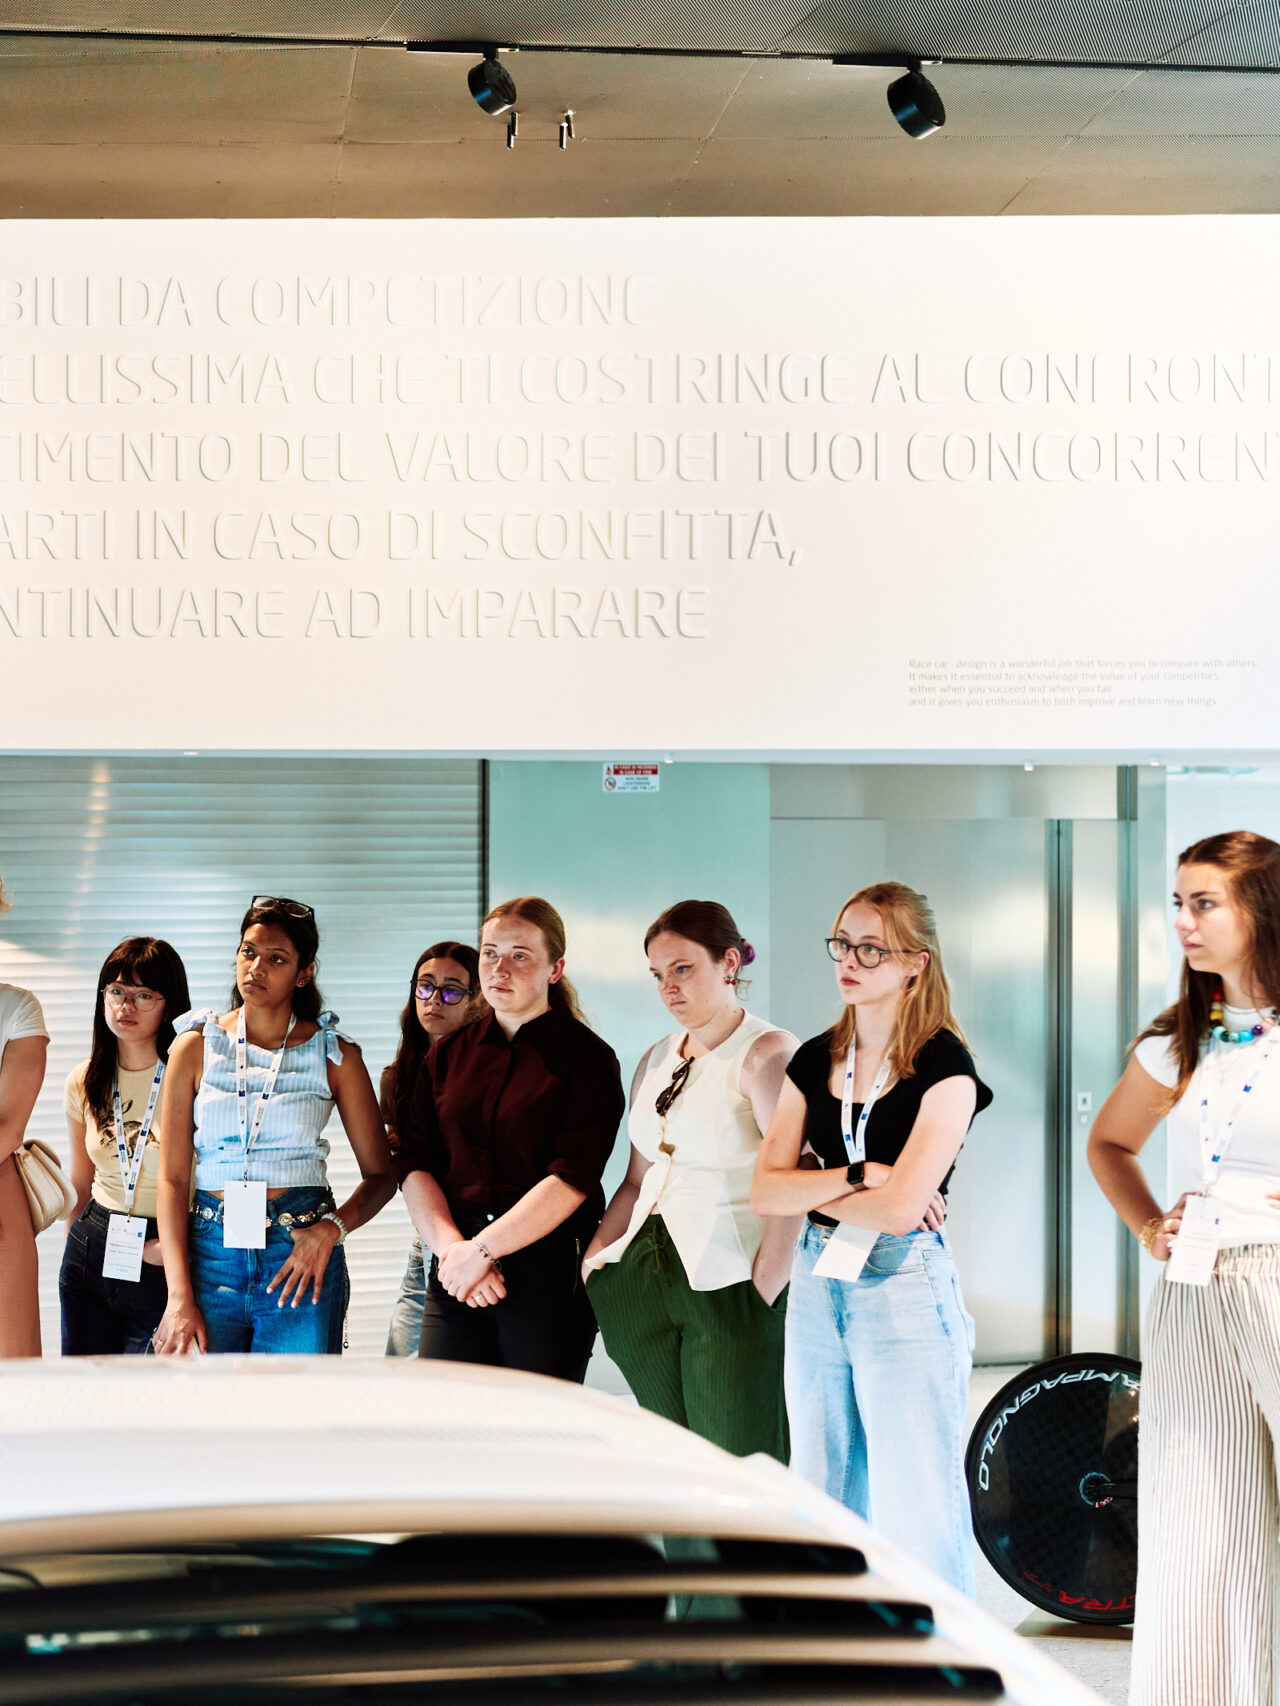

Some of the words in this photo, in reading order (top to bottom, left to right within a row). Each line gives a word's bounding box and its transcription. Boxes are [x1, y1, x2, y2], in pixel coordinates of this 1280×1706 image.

[118, 275, 197, 328] DA
[215, 275, 659, 328] COMPETIZIONE
[312, 353, 426, 405] CHE
[444, 353, 498, 405] TI
[519, 353, 854, 405] COSTRINGE
[870, 353, 944, 405] AL
[258, 431, 368, 483] DEL
[384, 431, 616, 483] VALORE
[632, 431, 727, 483] DEI
[743, 431, 887, 483] TUOI
[905, 431, 1280, 483] CONCORREN
[135, 509, 194, 561] IN
[211, 509, 368, 561] CASO
[387, 509, 442, 561] DI
[463, 509, 803, 567] SCONFITTA,
[304, 587, 389, 640] AD
[409, 587, 711, 640] IMPARARE
[909, 658, 932, 669] Race
[955, 658, 987, 670] design
[989, 658, 997, 669] is
[1007, 658, 1056, 669] wonderful
[1057, 658, 1072, 670] job
[1075, 658, 1094, 669] that
[1097, 658, 1126, 669] forces
[1128, 661, 1145, 670] you
[1148, 658, 1159, 669] to
[1160, 661, 1200, 670] compare
[1202, 658, 1224, 669] with
[918, 672, 948, 681] makes
[950, 672, 957, 681] it
[960, 672, 1002, 681] essential
[1005, 672, 1015, 681] to
[1017, 672, 1079, 682] acknowledge
[1081, 672, 1097, 681] the
[1099, 672, 1125, 681] value
[1127, 672, 1137, 681] of
[1139, 673, 1160, 682] your
[909, 684, 937, 694] either
[939, 684, 965, 694] when
[968, 686, 986, 695] you
[987, 684, 1026, 694] succeed
[1028, 684, 1045, 694] and
[1048, 684, 1074, 694] when
[1076, 686, 1095, 695] you
[909, 697, 926, 706] and
[928, 697, 936, 706] it
[938, 697, 963, 707] gives
[965, 699, 983, 707] you
[985, 697, 1040, 706] enthusiasm
[1042, 697, 1052, 706] to
[1054, 697, 1075, 706] both
[1078, 697, 1115, 707] improve
[1118, 697, 1135, 706] and
[1137, 697, 1161, 706] learn
[1163, 698, 1185, 706] new
[1059, 1590, 1136, 1611] TRA
